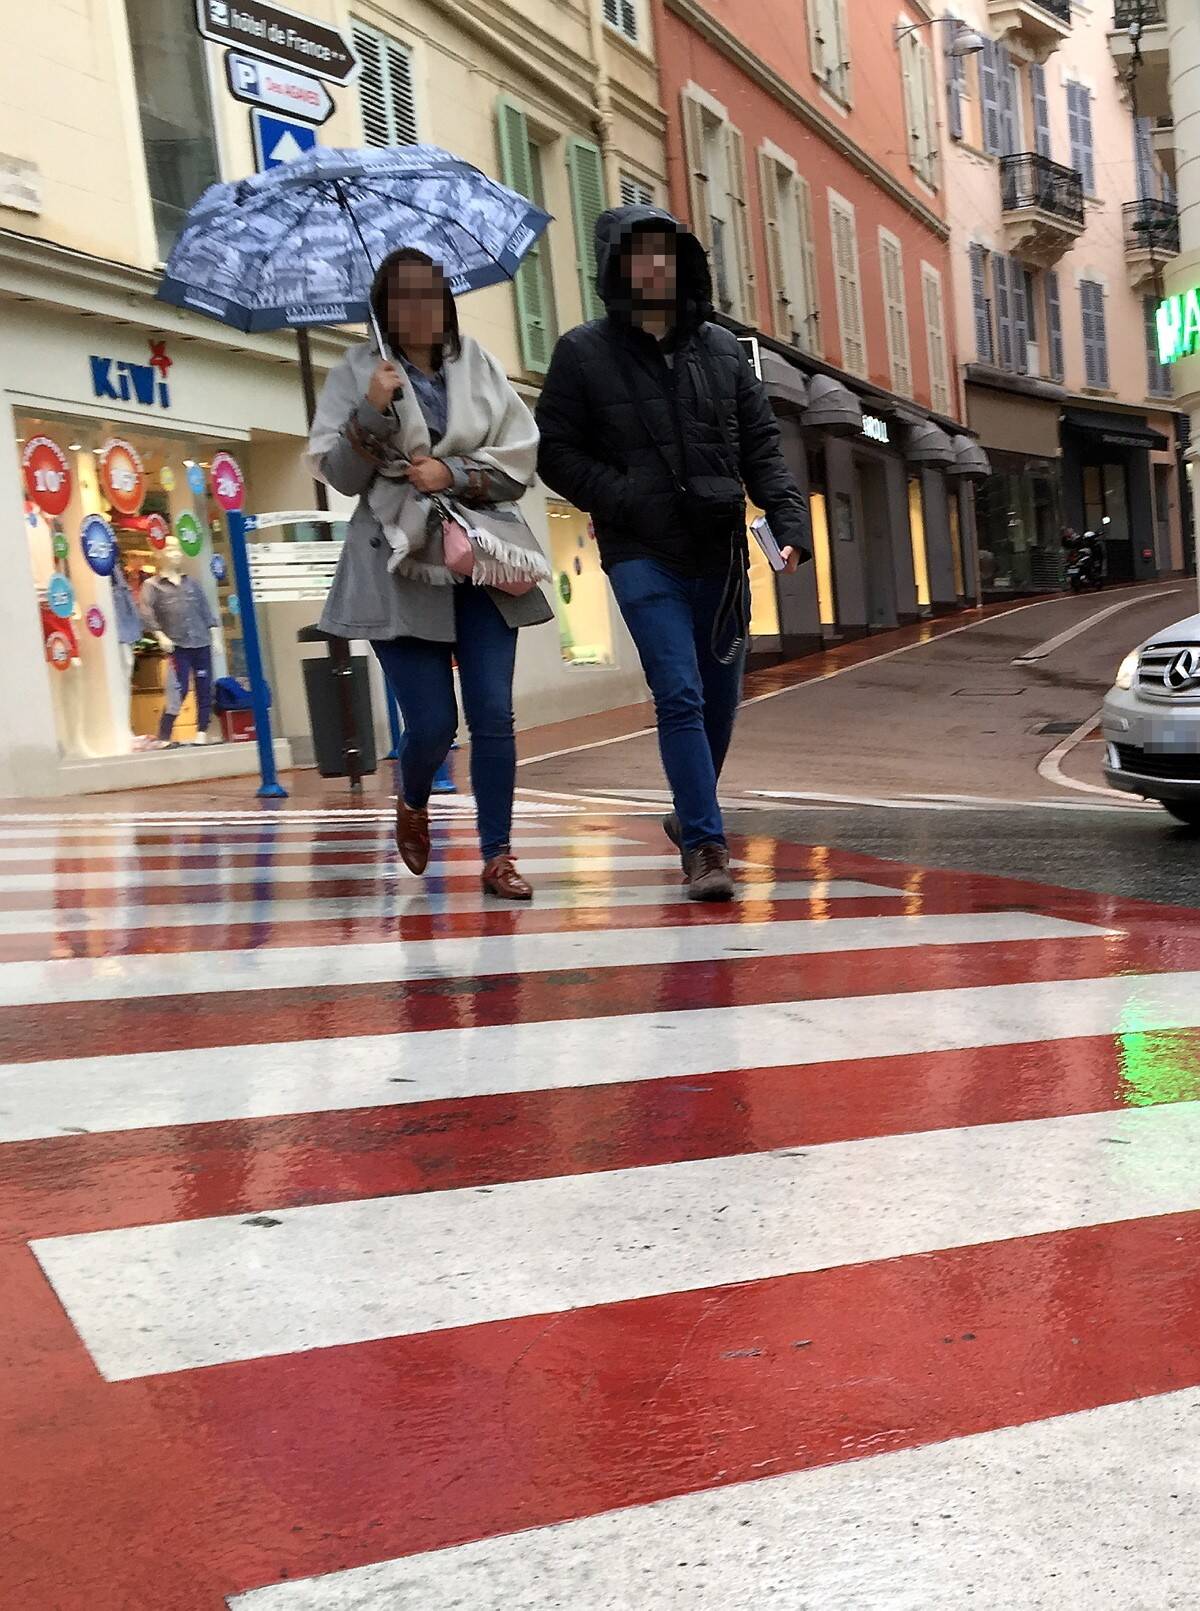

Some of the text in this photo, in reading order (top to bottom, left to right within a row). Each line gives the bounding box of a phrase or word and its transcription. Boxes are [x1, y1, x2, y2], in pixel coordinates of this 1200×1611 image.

[268, 24, 285, 44] de
[286, 29, 332, 61] France
[239, 62, 256, 90] P
